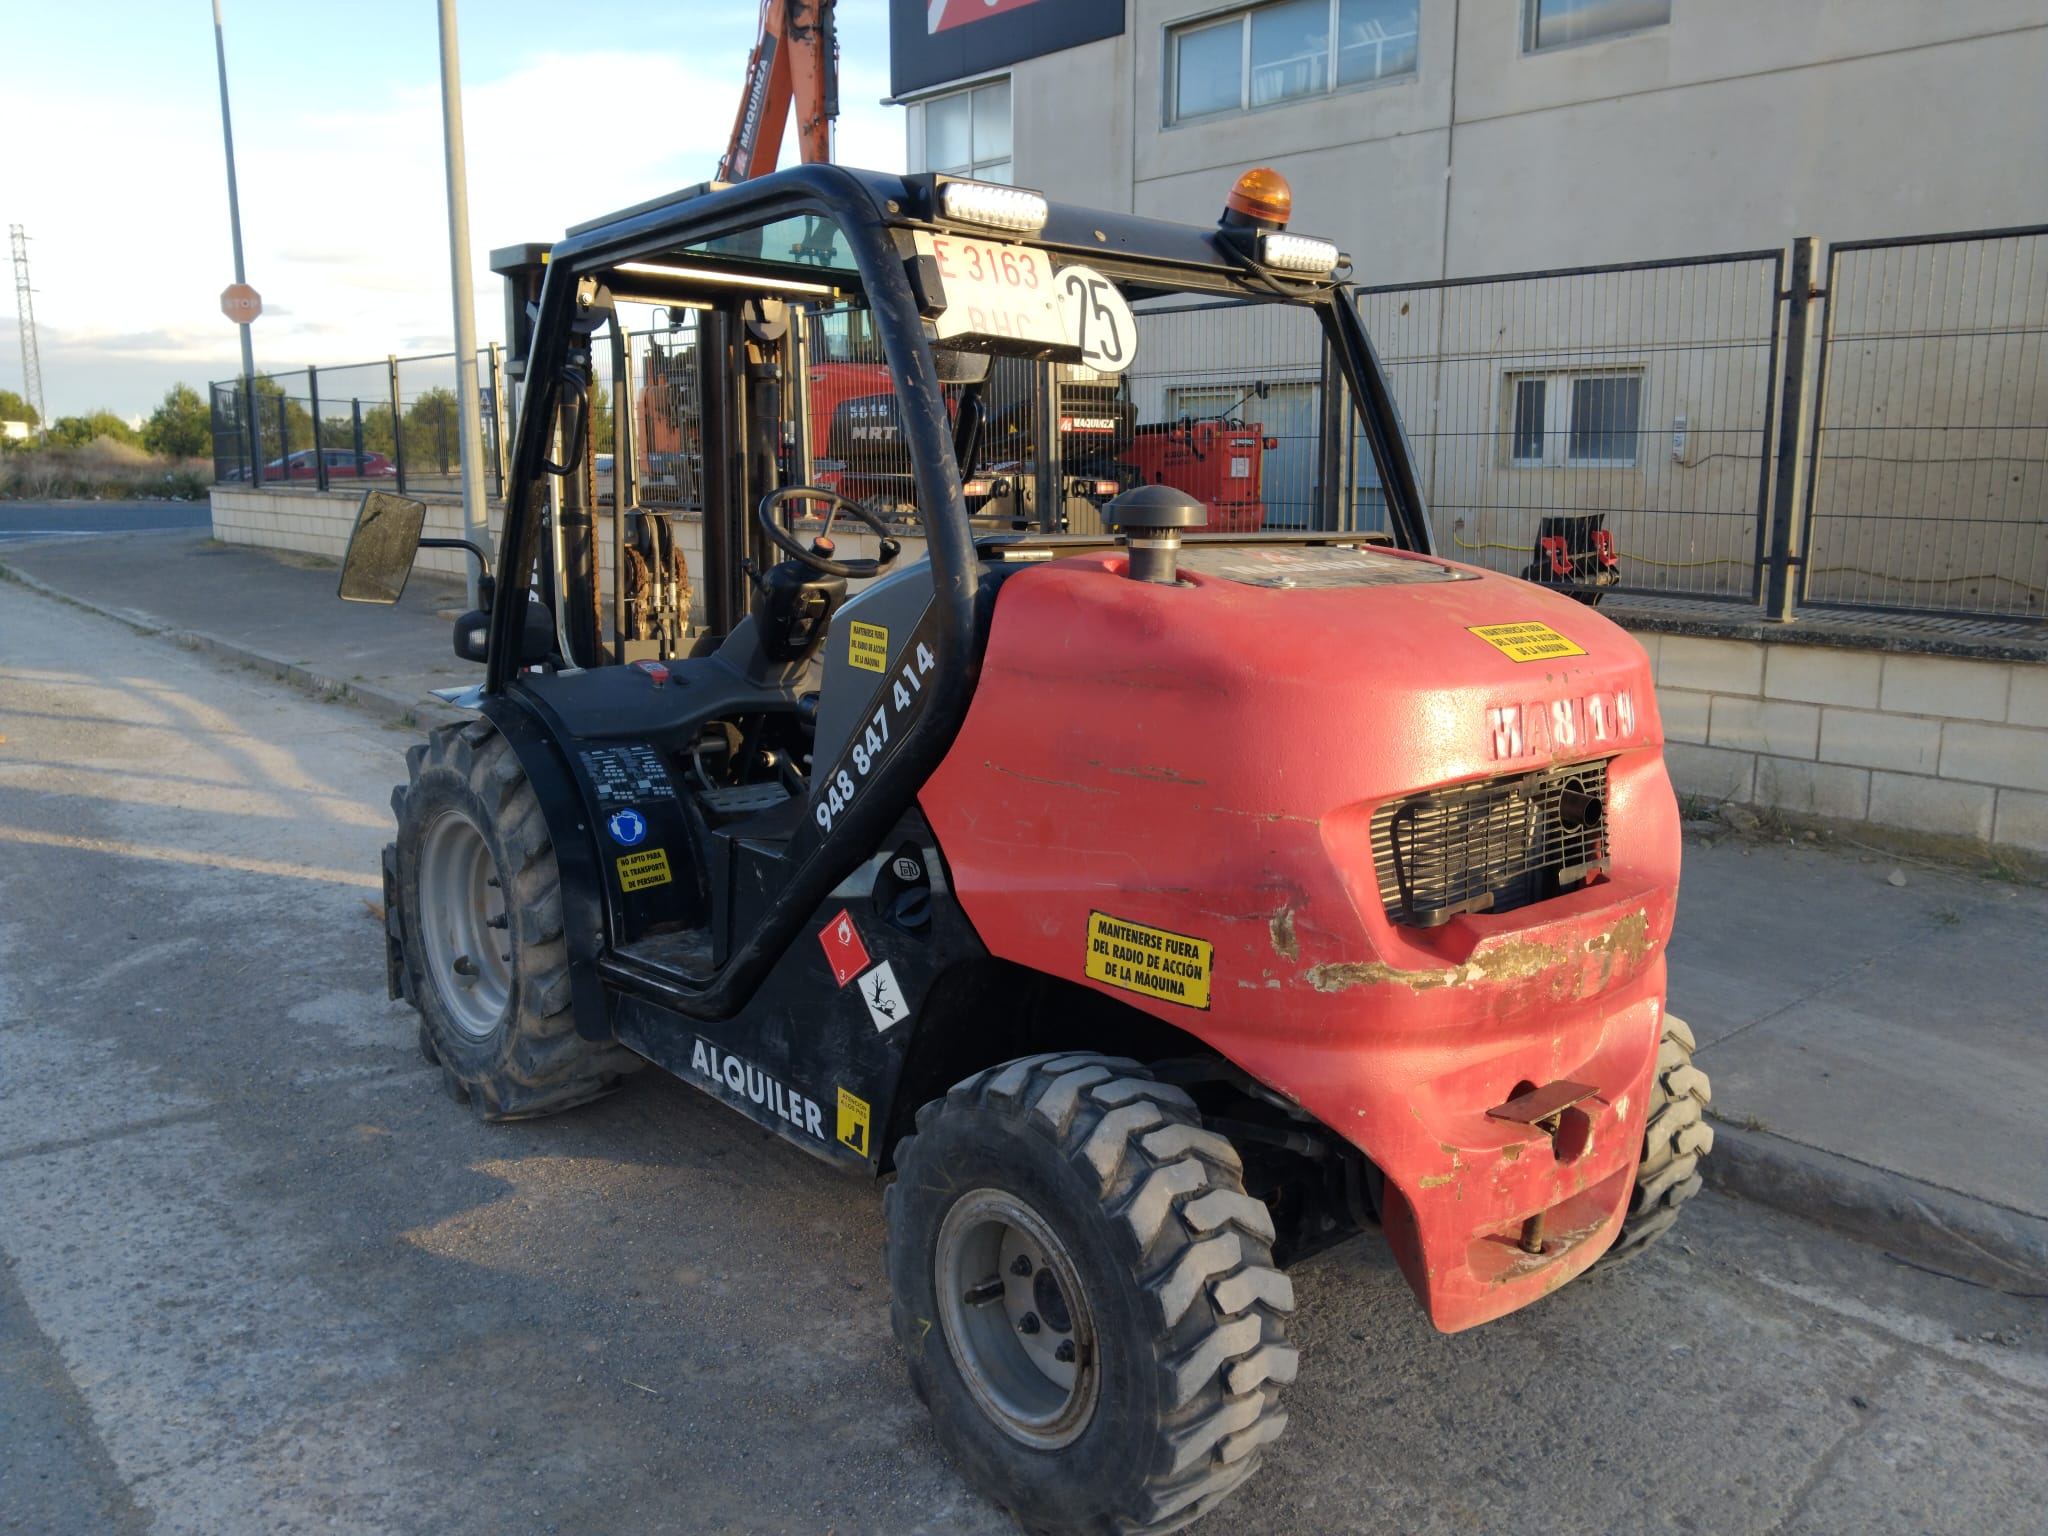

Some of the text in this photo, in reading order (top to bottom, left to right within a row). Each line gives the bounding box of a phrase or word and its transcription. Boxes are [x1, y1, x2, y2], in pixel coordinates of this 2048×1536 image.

[741, 59, 769, 149] MAQUINZA
[932, 239, 1040, 290] E 3163
[224, 297, 259, 310] STOP
[1066, 274, 1123, 363] 25
[852, 426, 898, 440] MRT
[1073, 417, 1115, 429] MAQUINZA
[815, 641, 935, 833] 948 847 414
[1093, 938, 1110, 956] DEL
[1112, 943, 1144, 965] RADIO
[1146, 953, 1160, 970] DE
[1098, 920, 1200, 960] MANTENERSE FUERA
[839, 969, 845, 980] 3
[1104, 961, 1117, 978] DE
[1119, 966, 1132, 982] LA
[691, 1039, 825, 1140] ALQUILER
